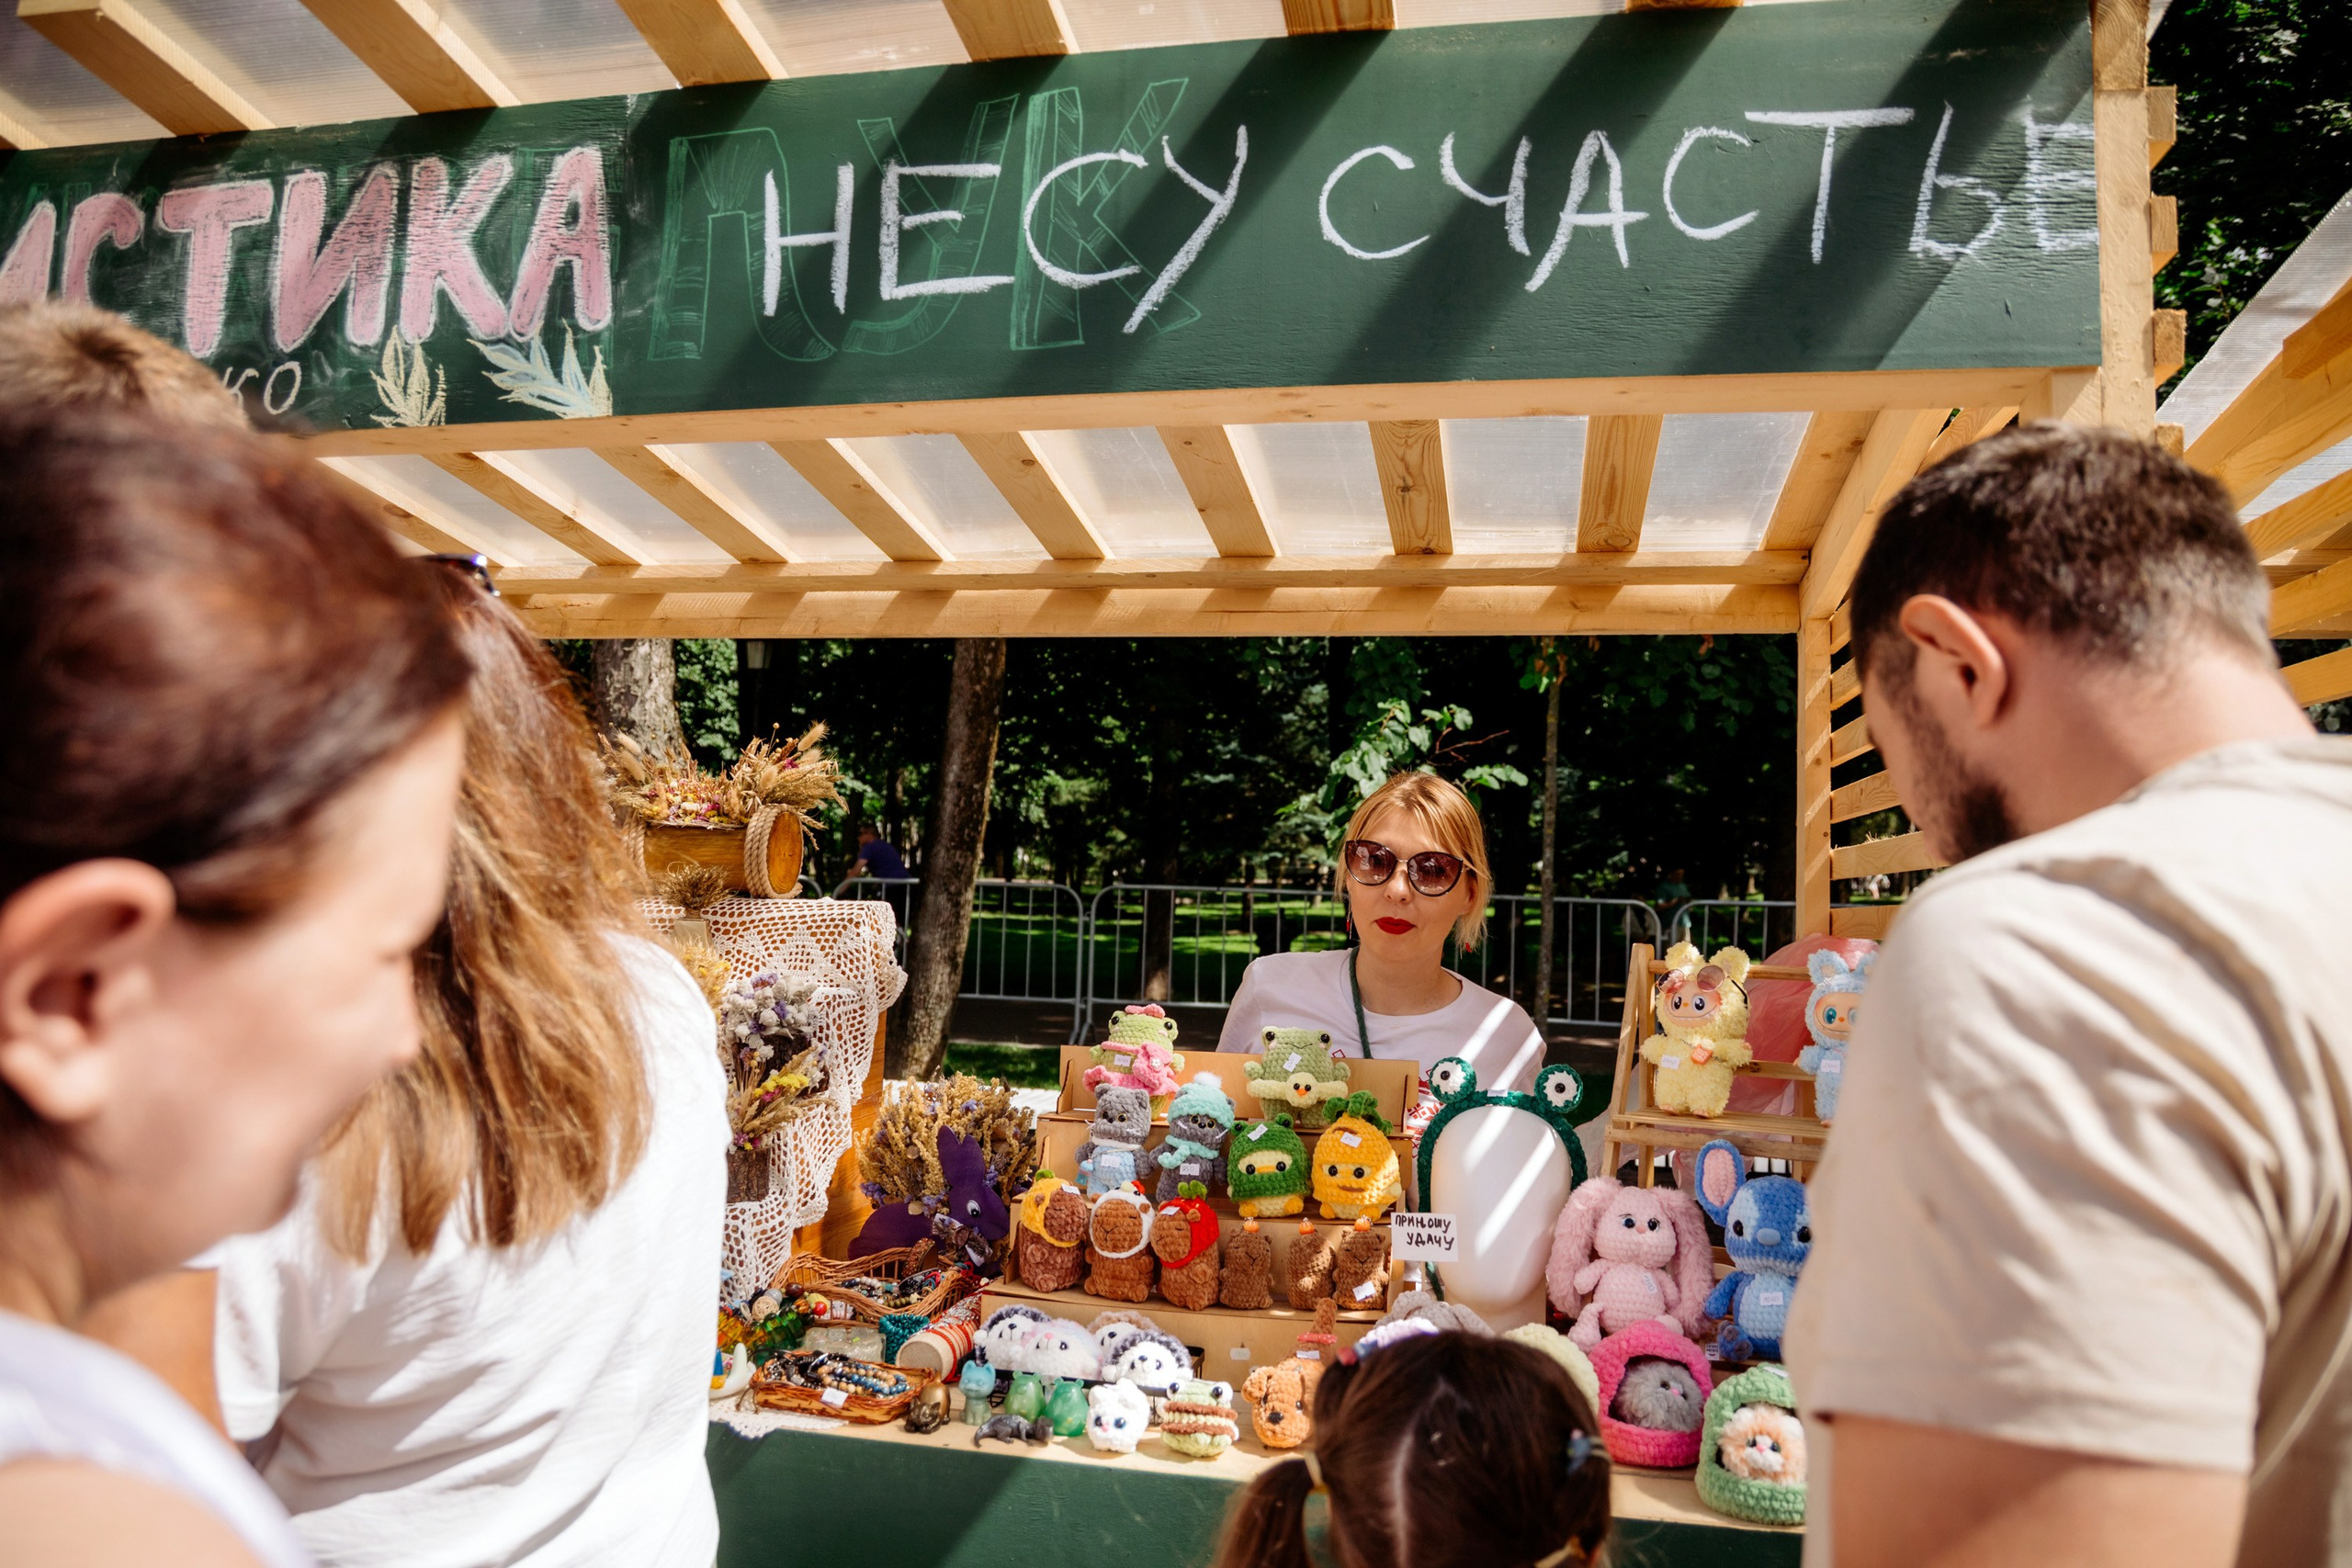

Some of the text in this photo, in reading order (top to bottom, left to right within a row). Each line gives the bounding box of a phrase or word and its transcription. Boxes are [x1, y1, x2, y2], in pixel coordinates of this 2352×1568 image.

[763, 99, 2100, 334] НЕСУ СЧАСТЬЕ
[1407, 1232, 1455, 1251] УДАЧУ
